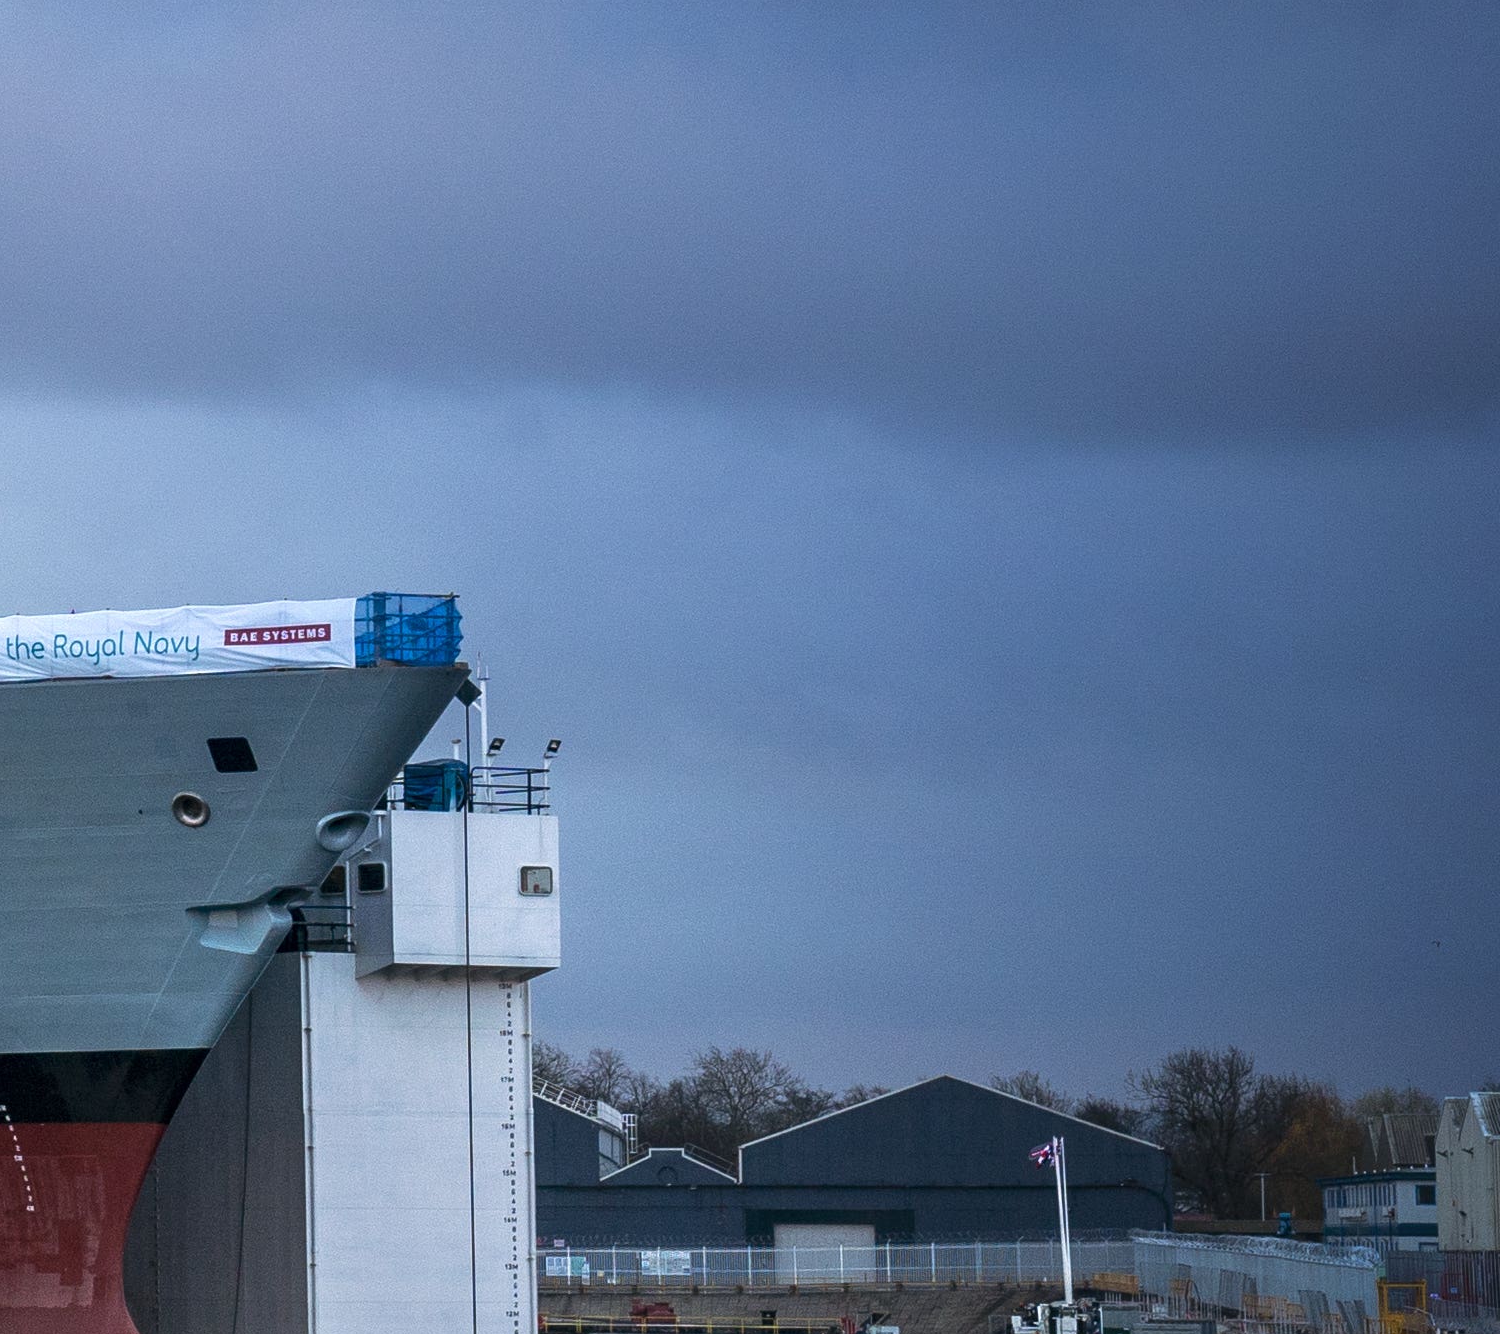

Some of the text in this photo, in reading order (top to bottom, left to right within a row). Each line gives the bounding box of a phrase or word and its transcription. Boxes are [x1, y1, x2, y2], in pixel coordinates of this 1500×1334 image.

[5, 635, 45, 660] the
[53, 630, 124, 666] Royal
[133, 631, 200, 661] Navy
[230, 627, 326, 643] BAE SYSTEMS
